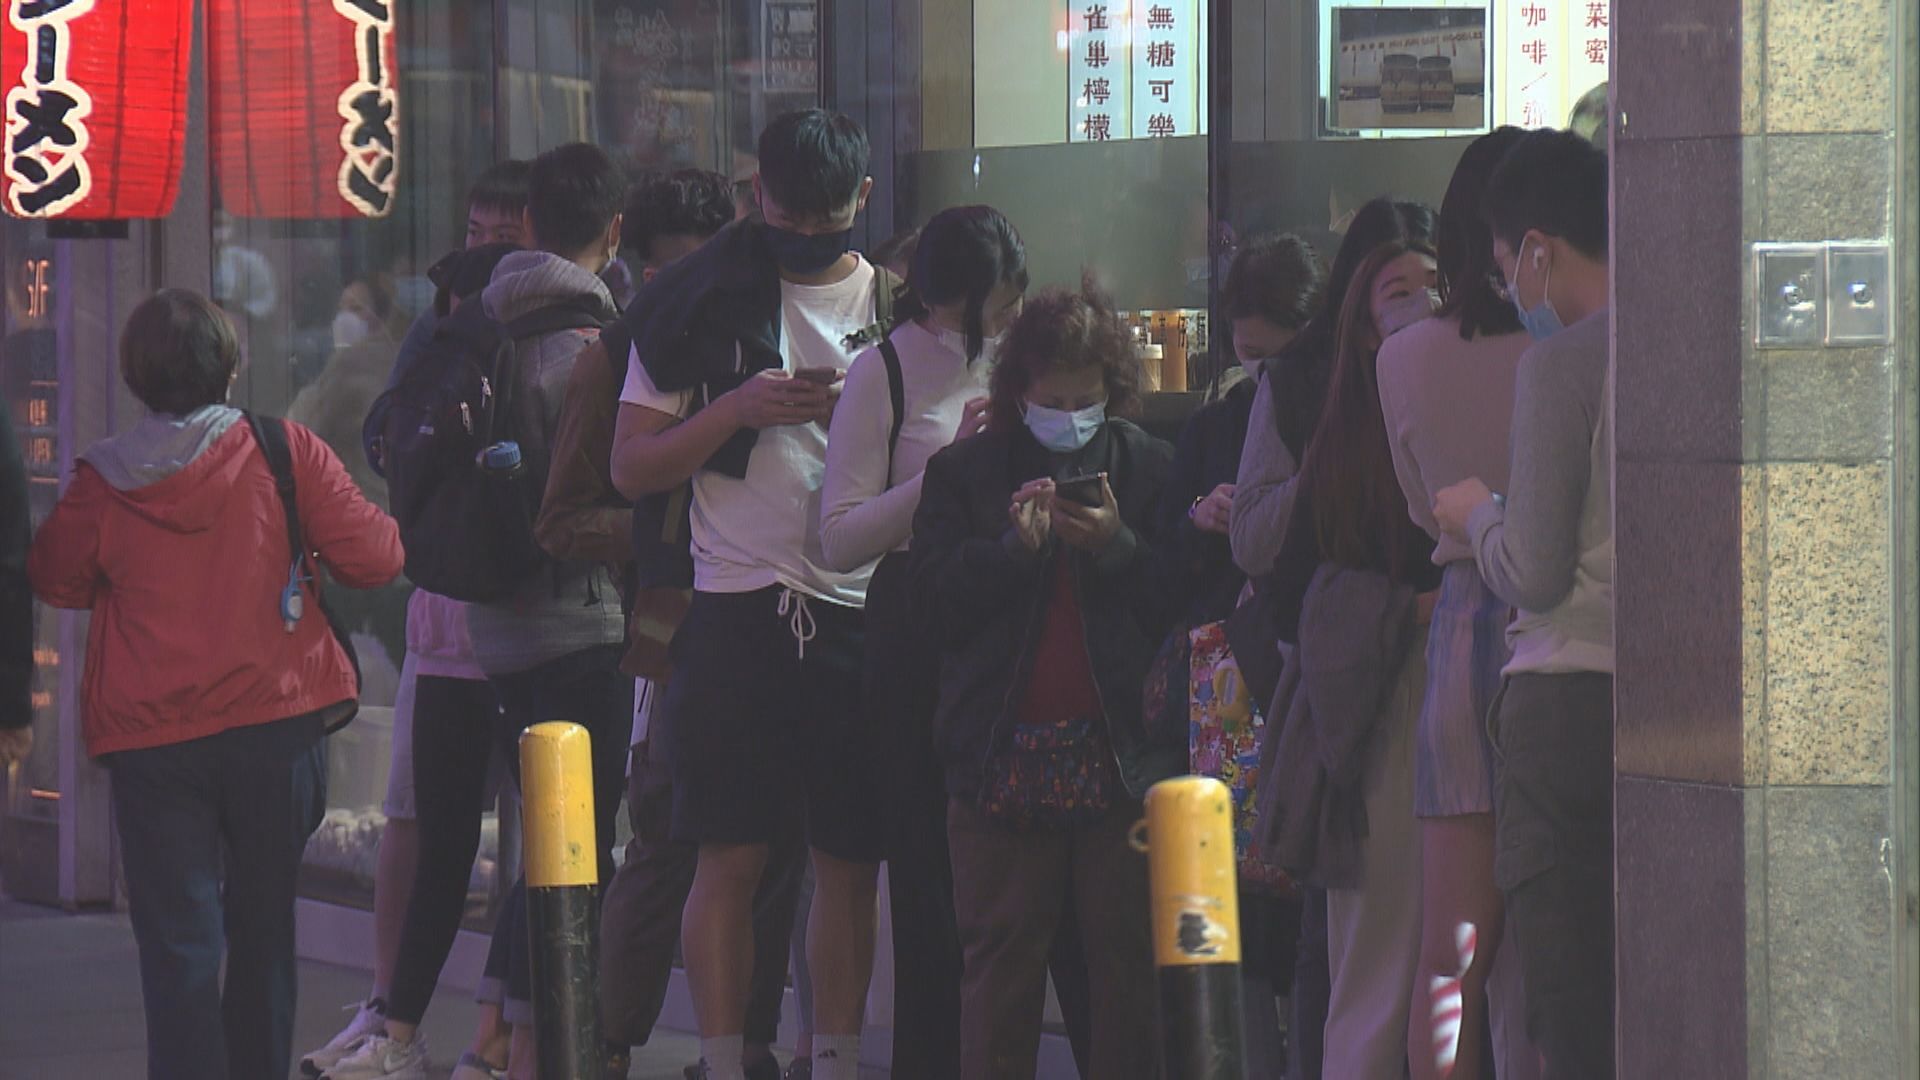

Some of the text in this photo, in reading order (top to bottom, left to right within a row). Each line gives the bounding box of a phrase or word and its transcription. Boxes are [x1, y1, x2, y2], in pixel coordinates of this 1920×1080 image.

[1083, 4, 1111, 140] 雀巢檸檬
[1146, 4, 1176, 137] 無糖可樂
